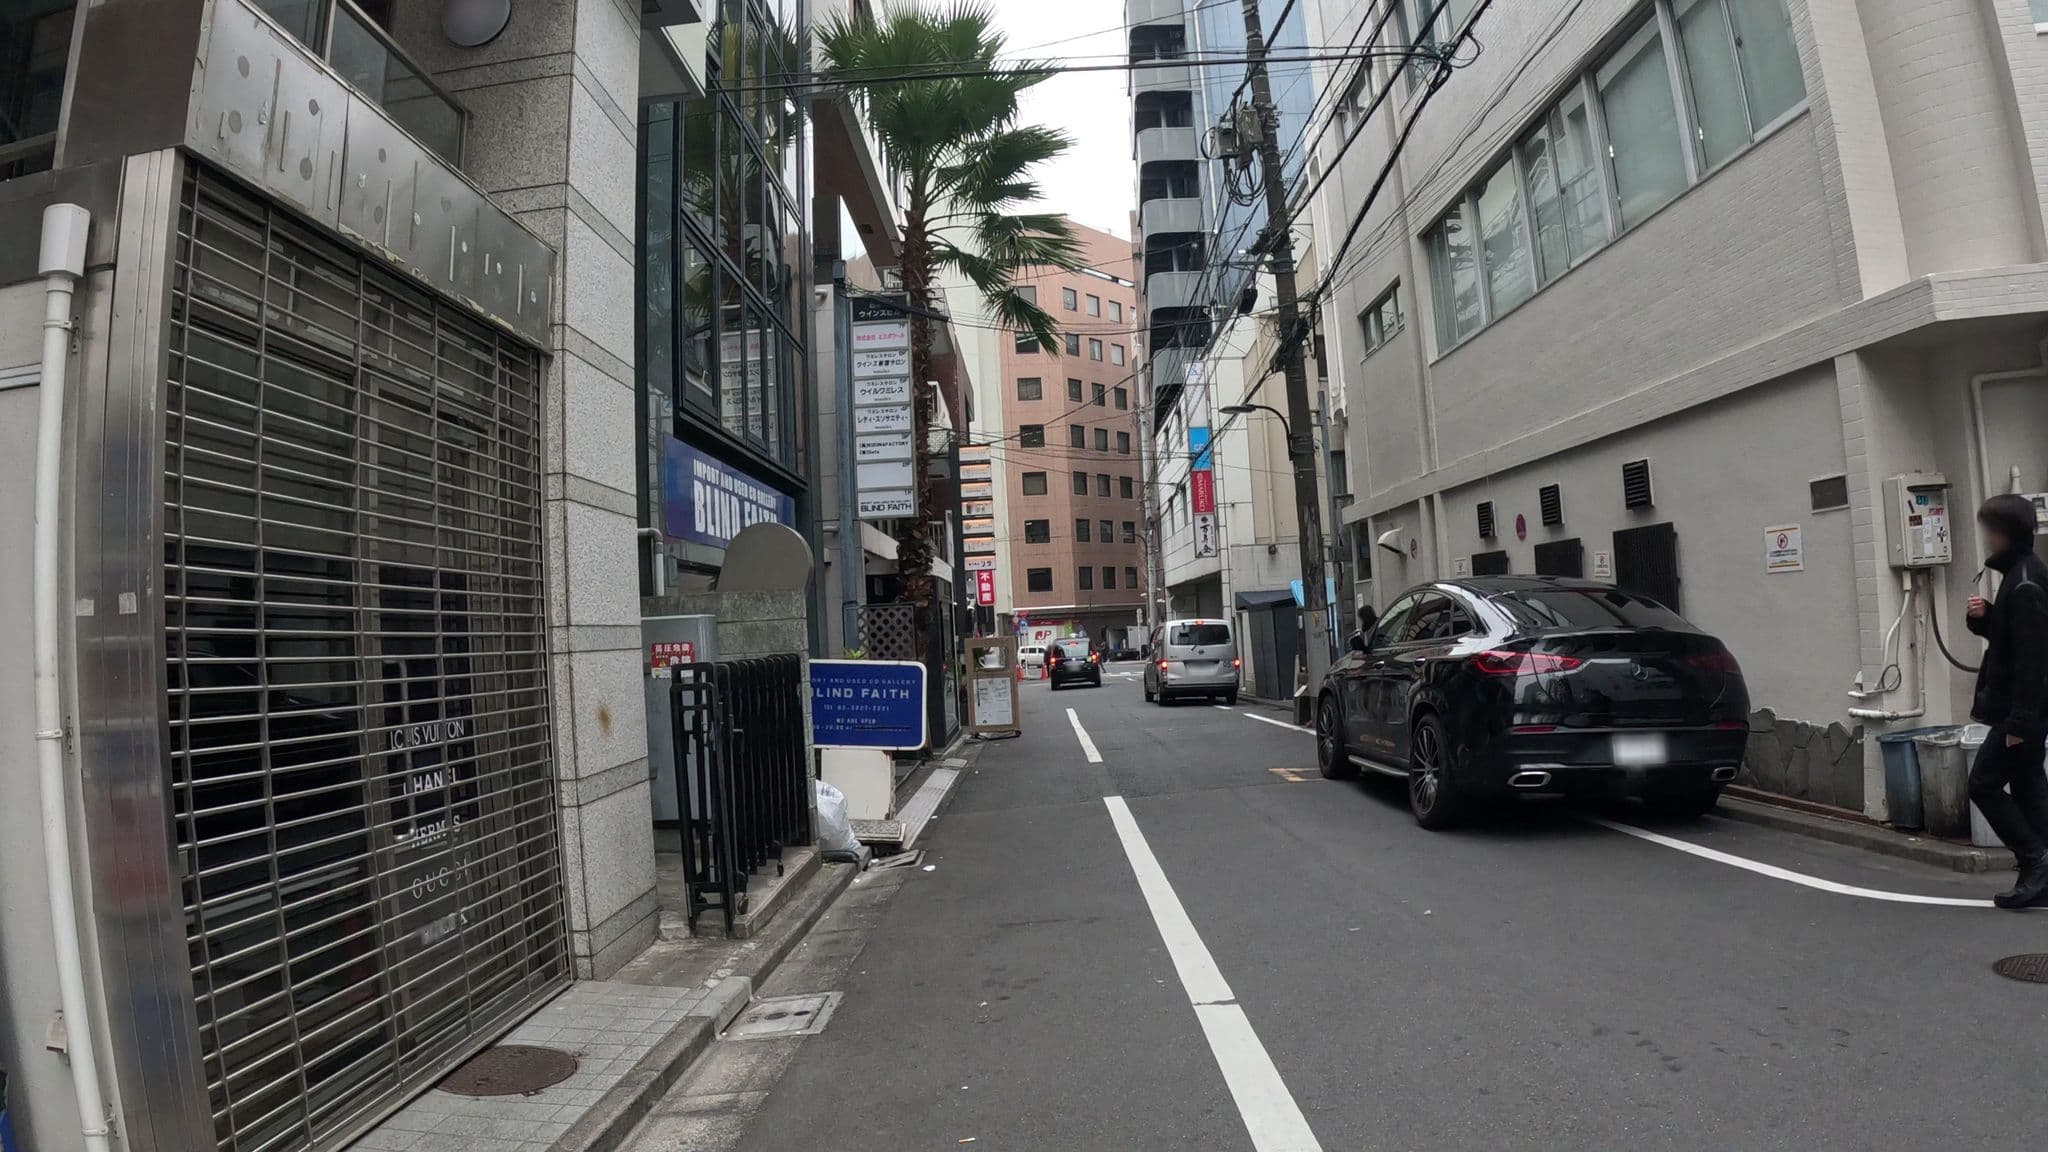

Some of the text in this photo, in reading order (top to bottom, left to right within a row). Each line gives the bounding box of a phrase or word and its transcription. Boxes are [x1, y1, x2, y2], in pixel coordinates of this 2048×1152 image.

[693, 458, 720, 485] IMPORT
[720, 471, 733, 492] AND
[733, 477, 748, 498] USED
[693, 479, 741, 540] BLIND
[860, 503, 912, 513] BLIND FAITH
[980, 572, 992, 602] 不動産
[810, 687, 910, 699] LIND FAITH
[390, 727, 421, 750] LOIS
